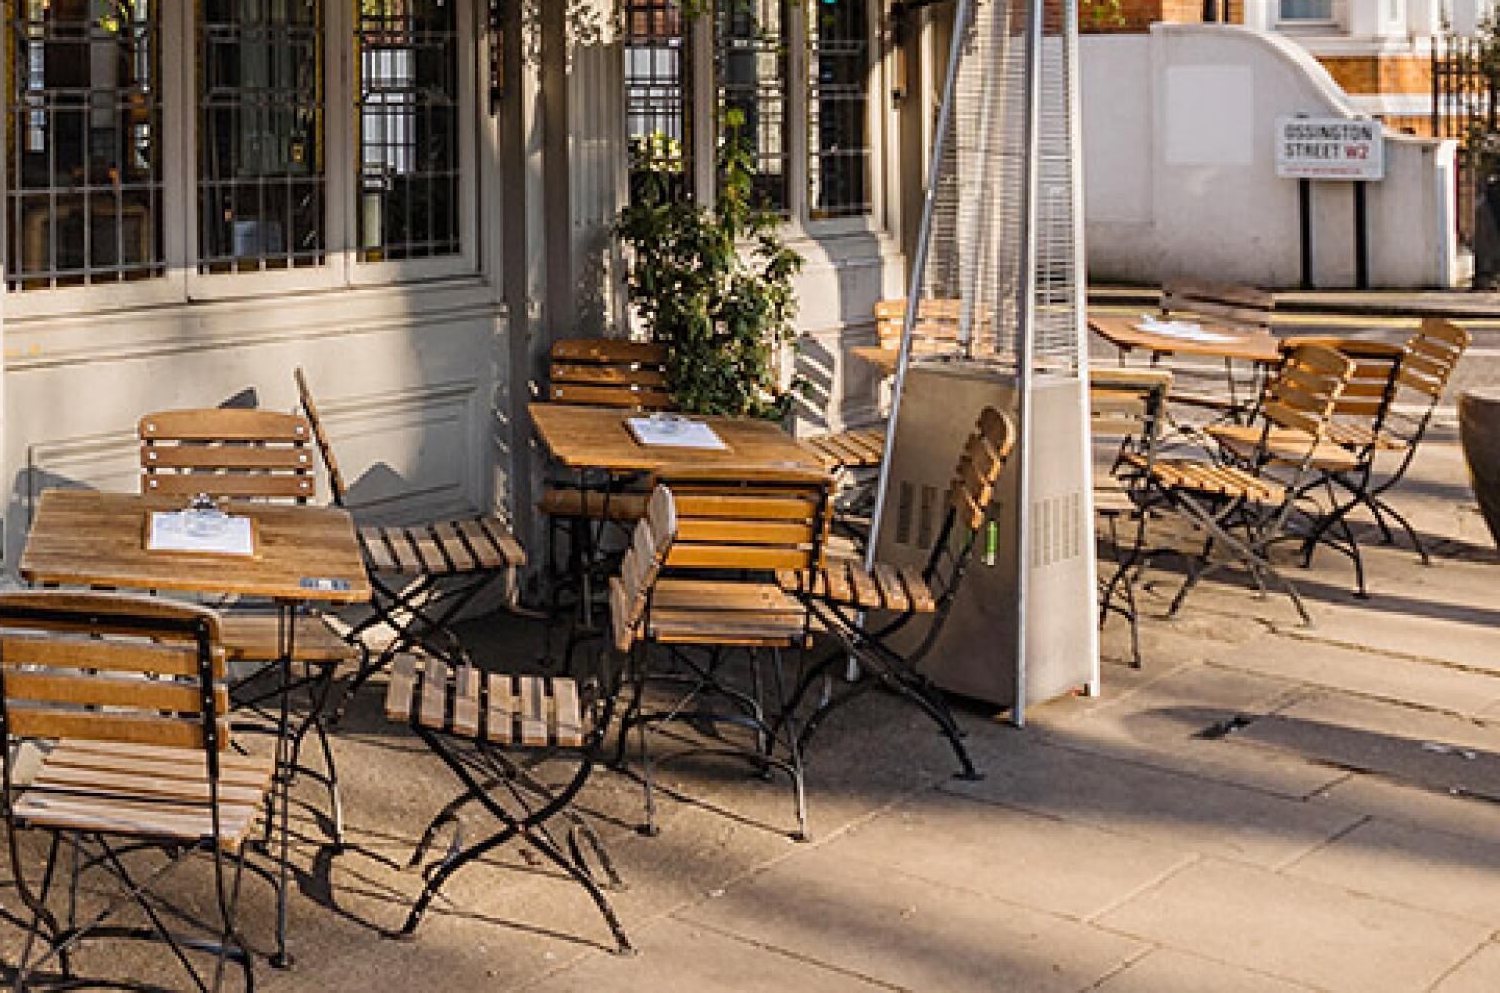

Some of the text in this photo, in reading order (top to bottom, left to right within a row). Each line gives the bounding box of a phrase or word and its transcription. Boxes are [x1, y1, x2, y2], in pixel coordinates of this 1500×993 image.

[1283, 124, 1372, 141] OSSINGTON
[1283, 142, 1370, 159] STREET W2
